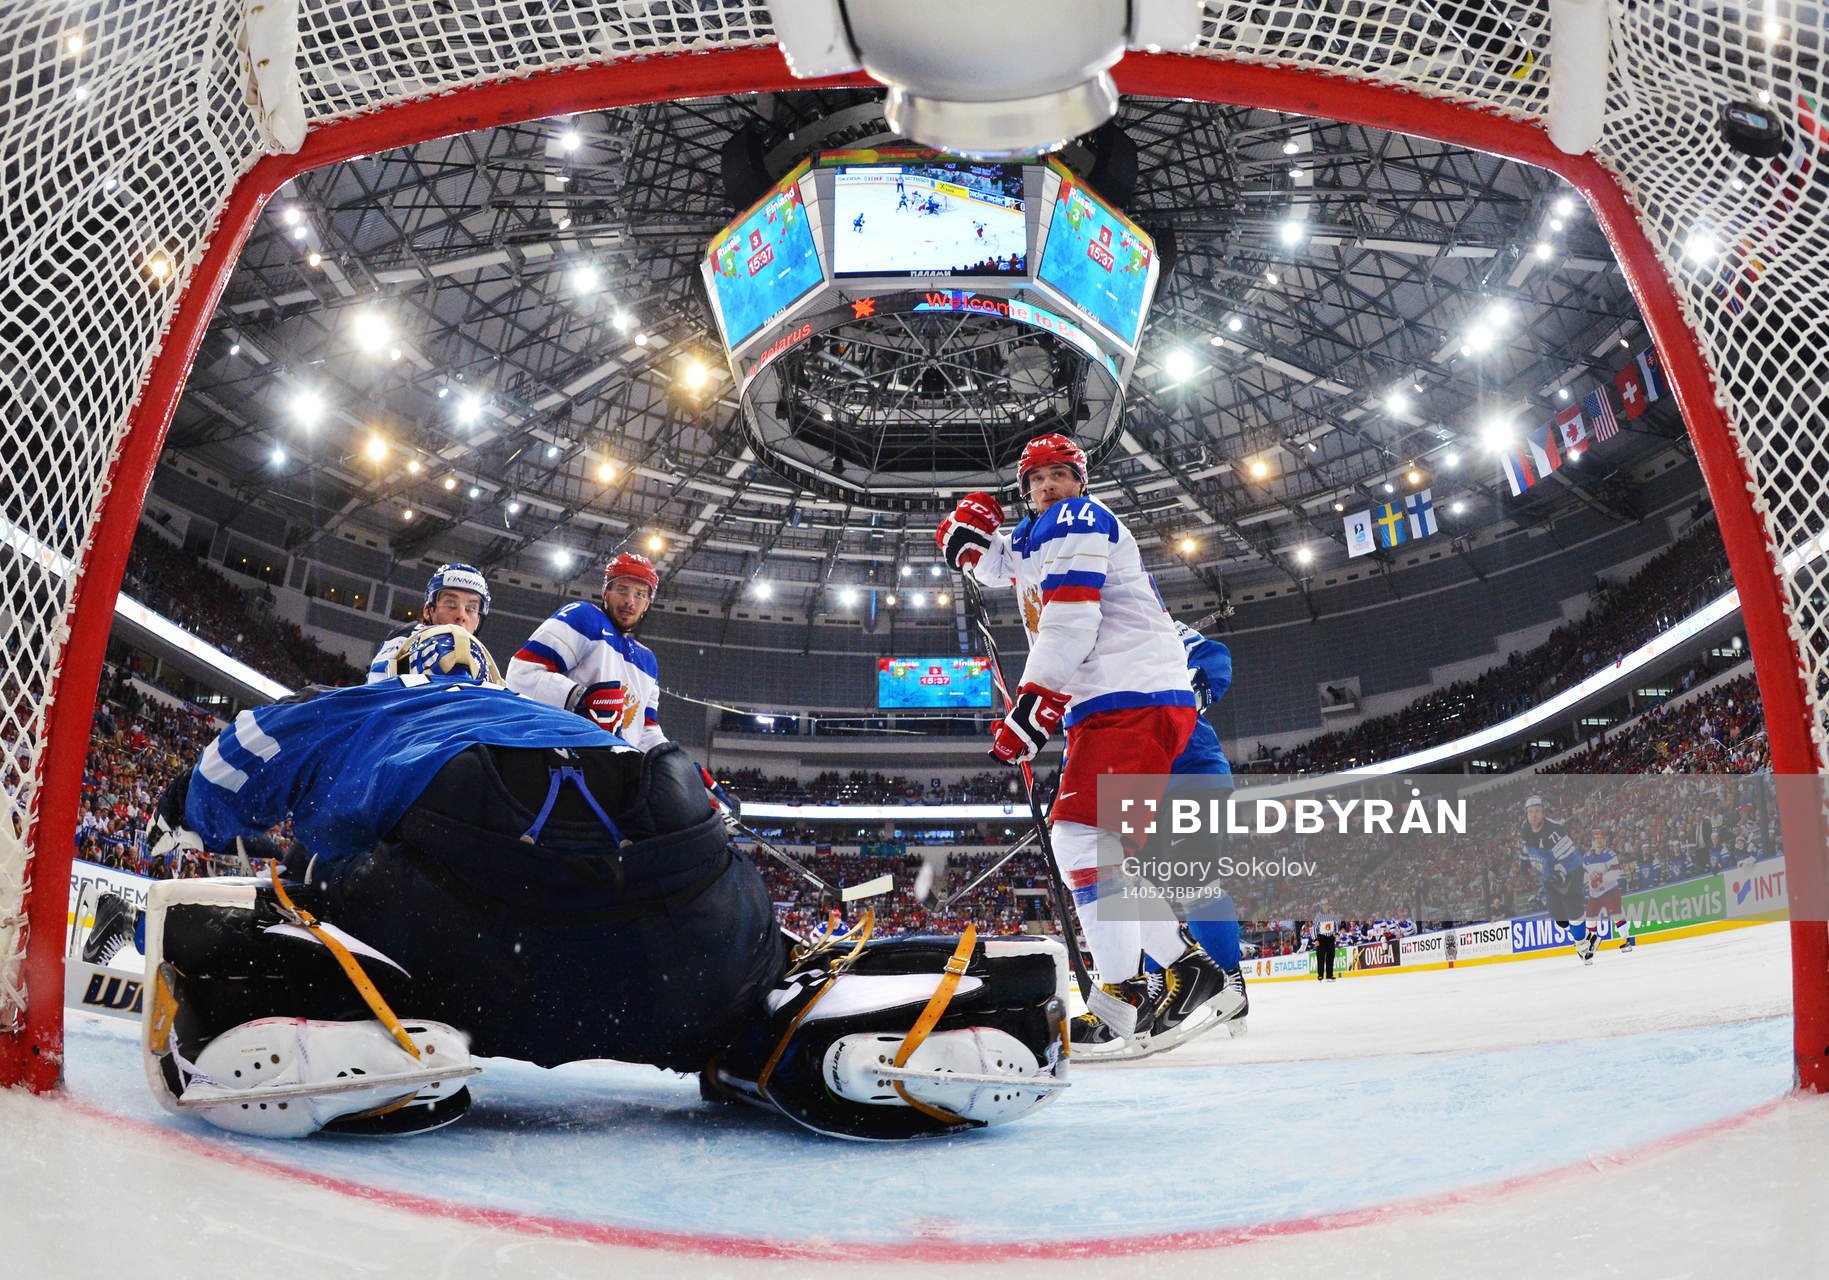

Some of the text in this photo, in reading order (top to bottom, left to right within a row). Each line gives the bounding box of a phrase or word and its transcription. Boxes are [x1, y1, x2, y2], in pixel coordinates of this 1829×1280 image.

[765, 187, 795, 216] Finland
[1069, 187, 1096, 215] Russia
[785, 208, 794, 222] 2
[1072, 209, 1080, 221] 3
[716, 235, 741, 259] Russia
[1089, 244, 1114, 270] 15:37
[1122, 230, 1148, 259] Finland
[726, 259, 734, 271] 3
[748, 246, 772, 273] 15:37
[1132, 259, 1140, 272] 2
[926, 292, 1028, 319] Welcome
[1035, 311, 1053, 328] to
[760, 323, 813, 363] Belarus
[1056, 502, 1096, 527] 44
[1473, 926, 1510, 944] TISSOT
[1513, 906, 1609, 949] SAMSG
[1412, 937, 1442, 953] TISSOT
[1274, 959, 1308, 972] STADLER
